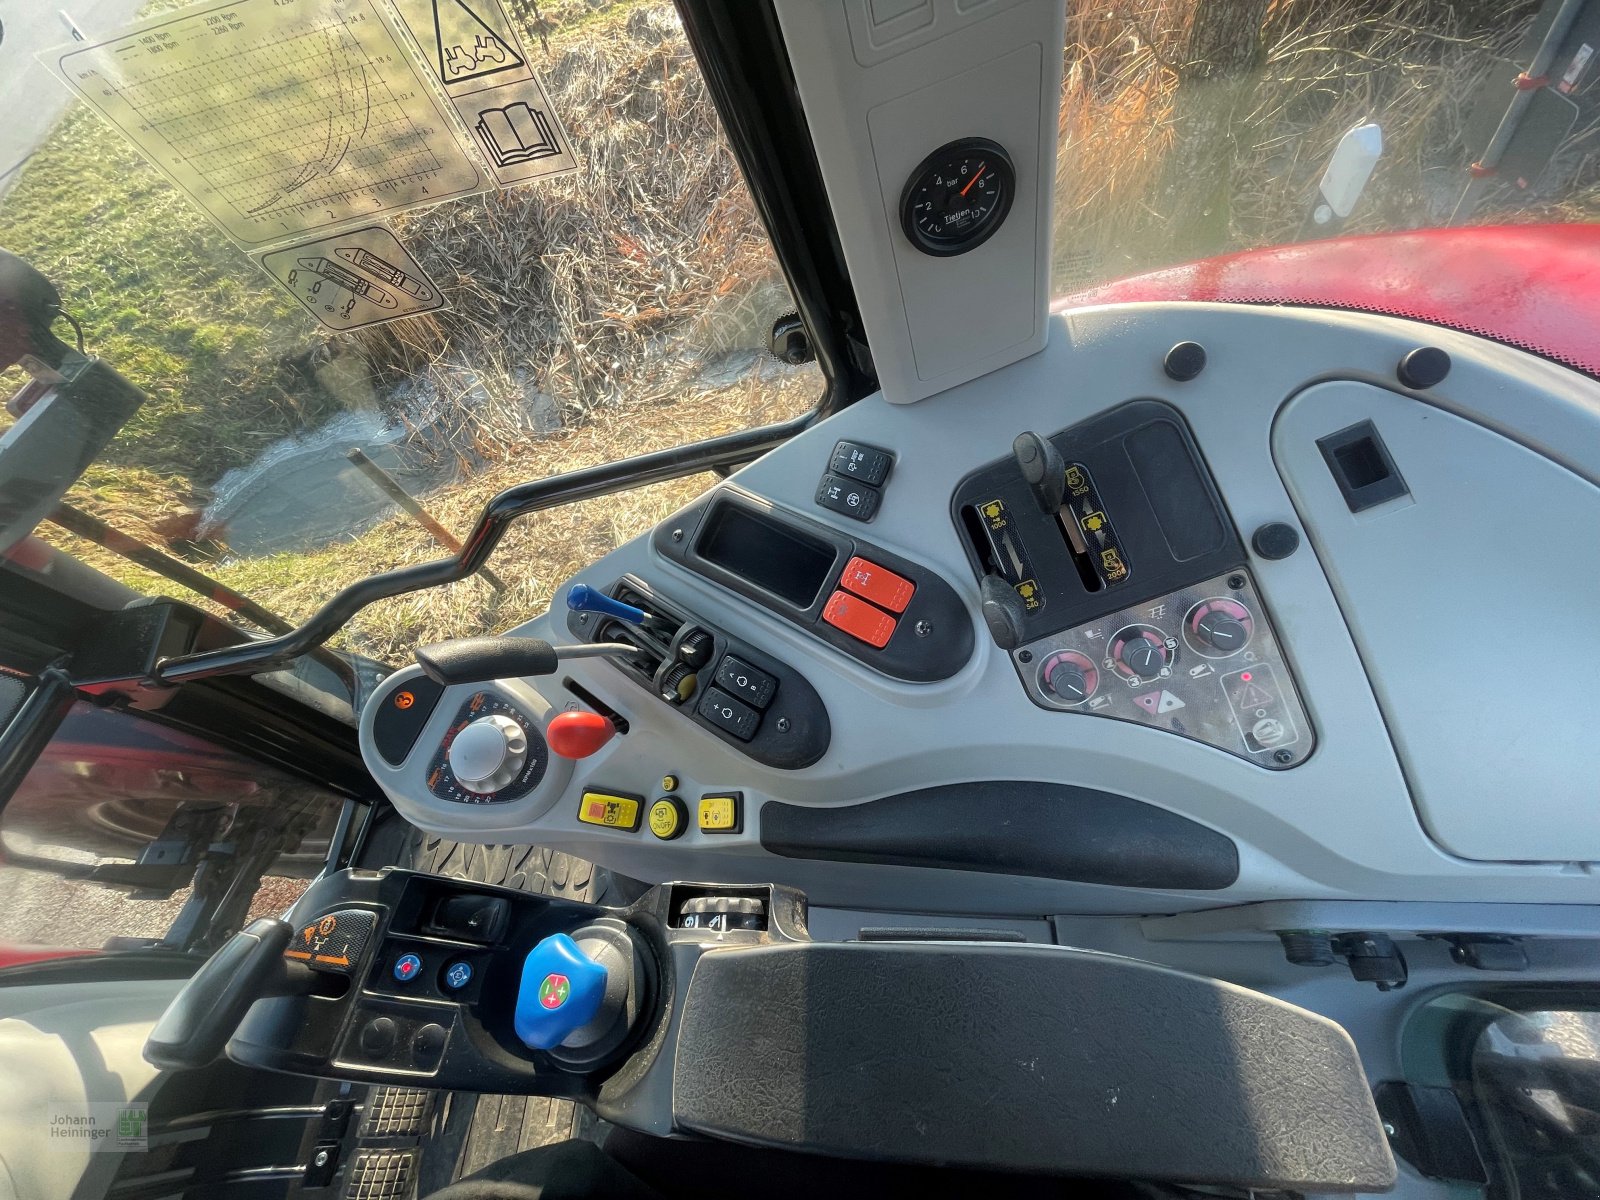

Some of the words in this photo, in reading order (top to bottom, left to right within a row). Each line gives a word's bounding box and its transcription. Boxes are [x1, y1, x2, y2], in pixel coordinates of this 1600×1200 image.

[203, 16, 221, 26] 2200
[221, 12, 238, 21] Rpm
[228, 22, 246, 30] Rpm
[154, 32, 171, 41] Rpm
[162, 42, 180, 50] Rpm
[960, 165, 968, 174] 6
[935, 176, 942, 185] 4
[946, 178, 959, 187] bar
[978, 179, 985, 188] 8
[422, 185, 429, 194] 4
[372, 198, 381, 207] 3
[925, 202, 932, 211] 2
[326, 210, 337, 219] 2
[280, 222, 288, 230] 1
[1072, 486, 1090, 497] 1550
[991, 520, 1007, 530] 1000
[1165, 638, 1177, 648] 5
[1104, 658, 1114, 669] 2
[1129, 677, 1140, 687] 3
